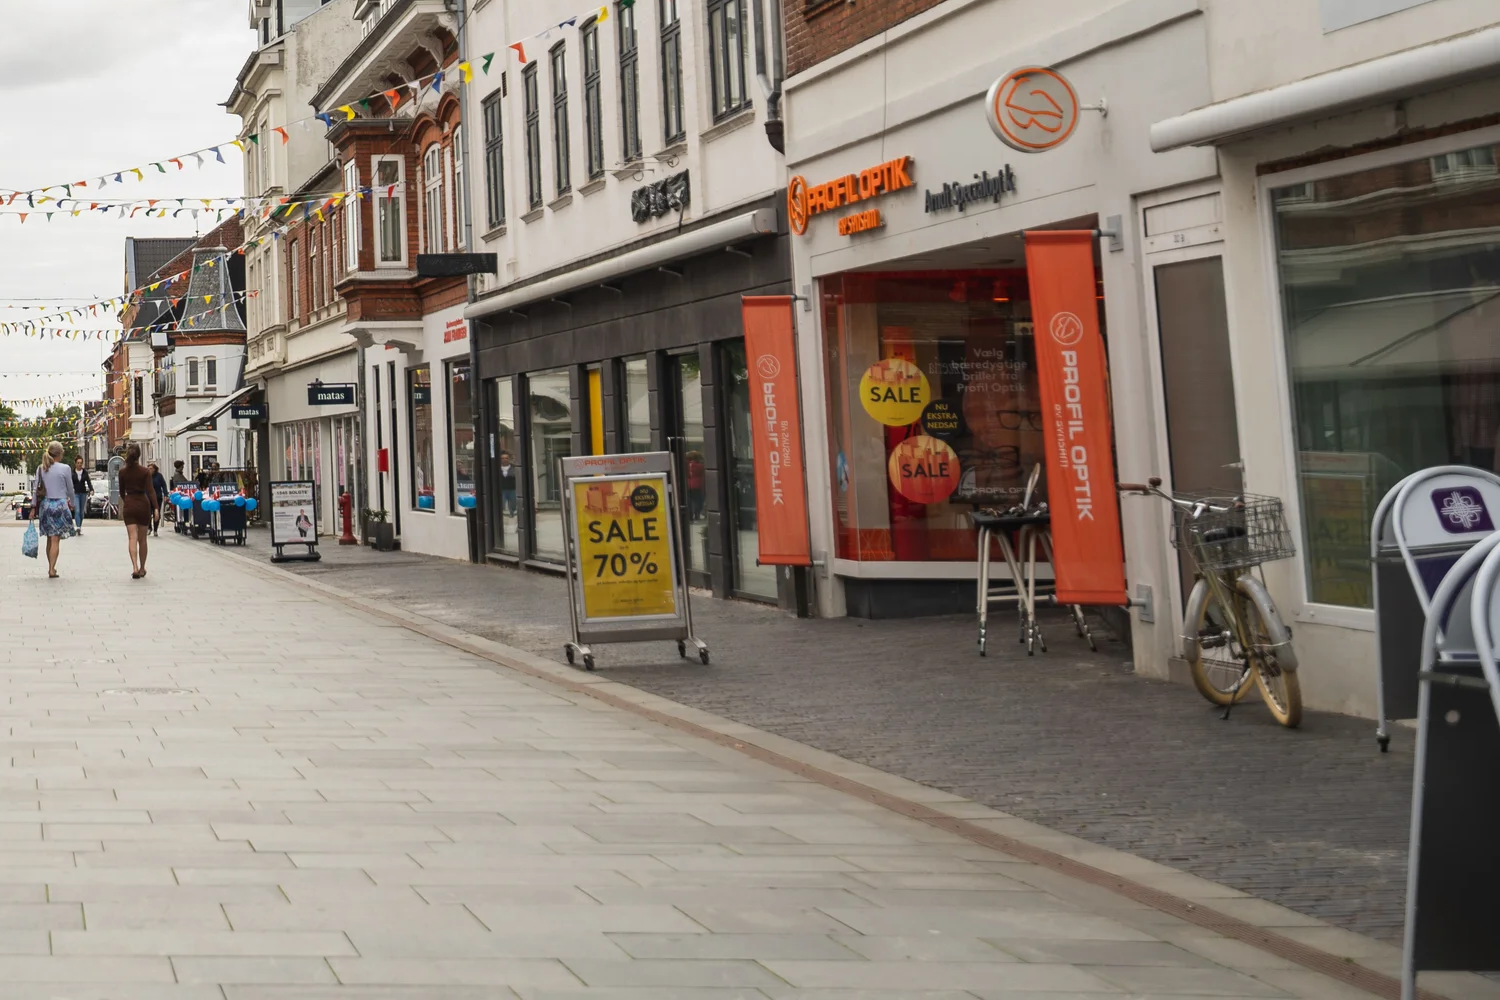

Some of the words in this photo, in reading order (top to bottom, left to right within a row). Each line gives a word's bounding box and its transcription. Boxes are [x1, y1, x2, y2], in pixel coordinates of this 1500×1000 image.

[807, 173, 859, 215] PROFIL
[859, 155, 914, 198] OPTIK
[973, 347, 1003, 359] Vælg
[963, 371, 997, 381] briller
[870, 386, 921, 403] SALE
[956, 382, 989, 393] Profil
[992, 382, 1025, 395] Optik
[317, 391, 345, 401] matas
[1061, 350, 1084, 441] PROFIL
[238, 408, 260, 416] matas
[927, 412, 958, 420] EKSTRA
[927, 421, 958, 429] NEDSAT
[584, 459, 616, 467] PROFIL
[902, 462, 950, 479] SALE
[1071, 445, 1094, 521] OPTIK
[588, 517, 660, 543] SALE
